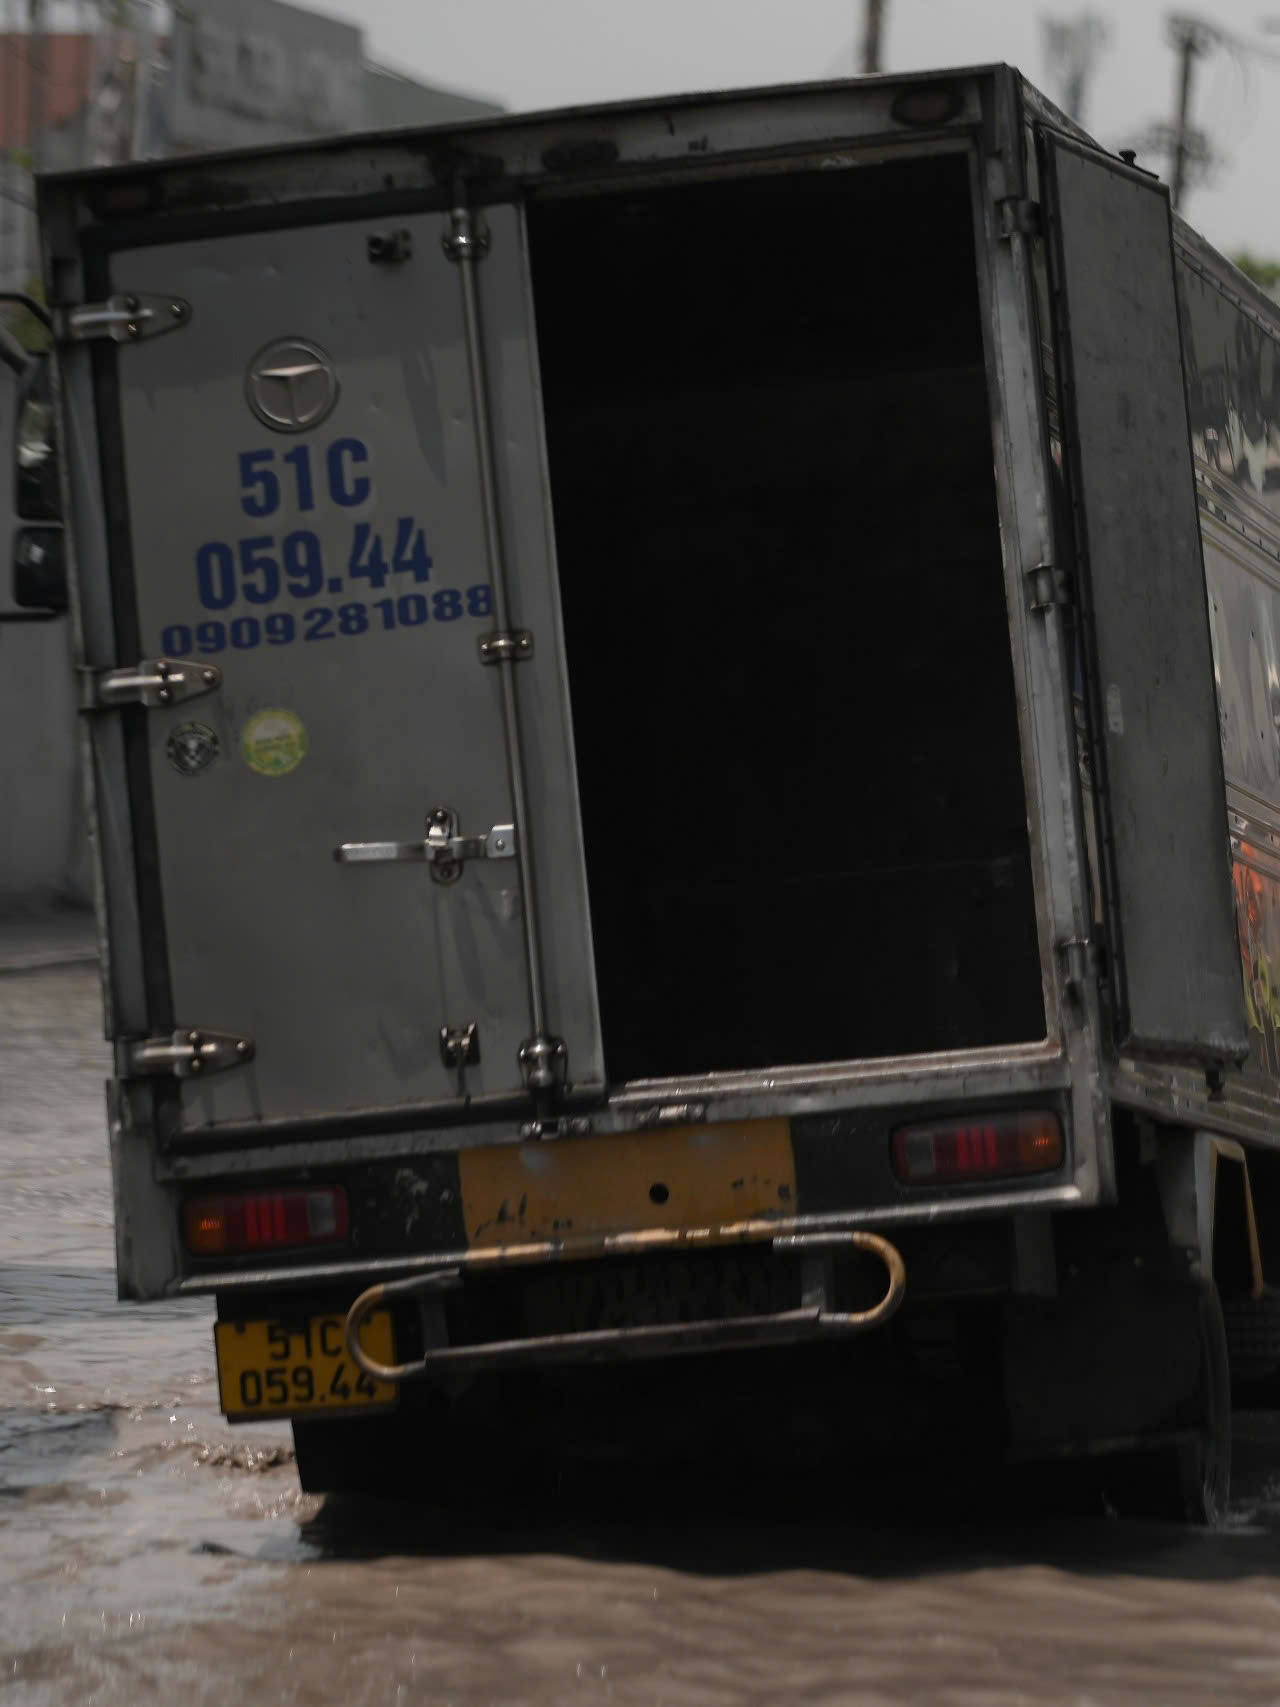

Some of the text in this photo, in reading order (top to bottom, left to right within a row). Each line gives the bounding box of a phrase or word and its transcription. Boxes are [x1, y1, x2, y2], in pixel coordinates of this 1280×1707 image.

[238, 437, 372, 518] 51C
[195, 516, 433, 610] 059.44
[160, 583, 494, 657] 0909281088
